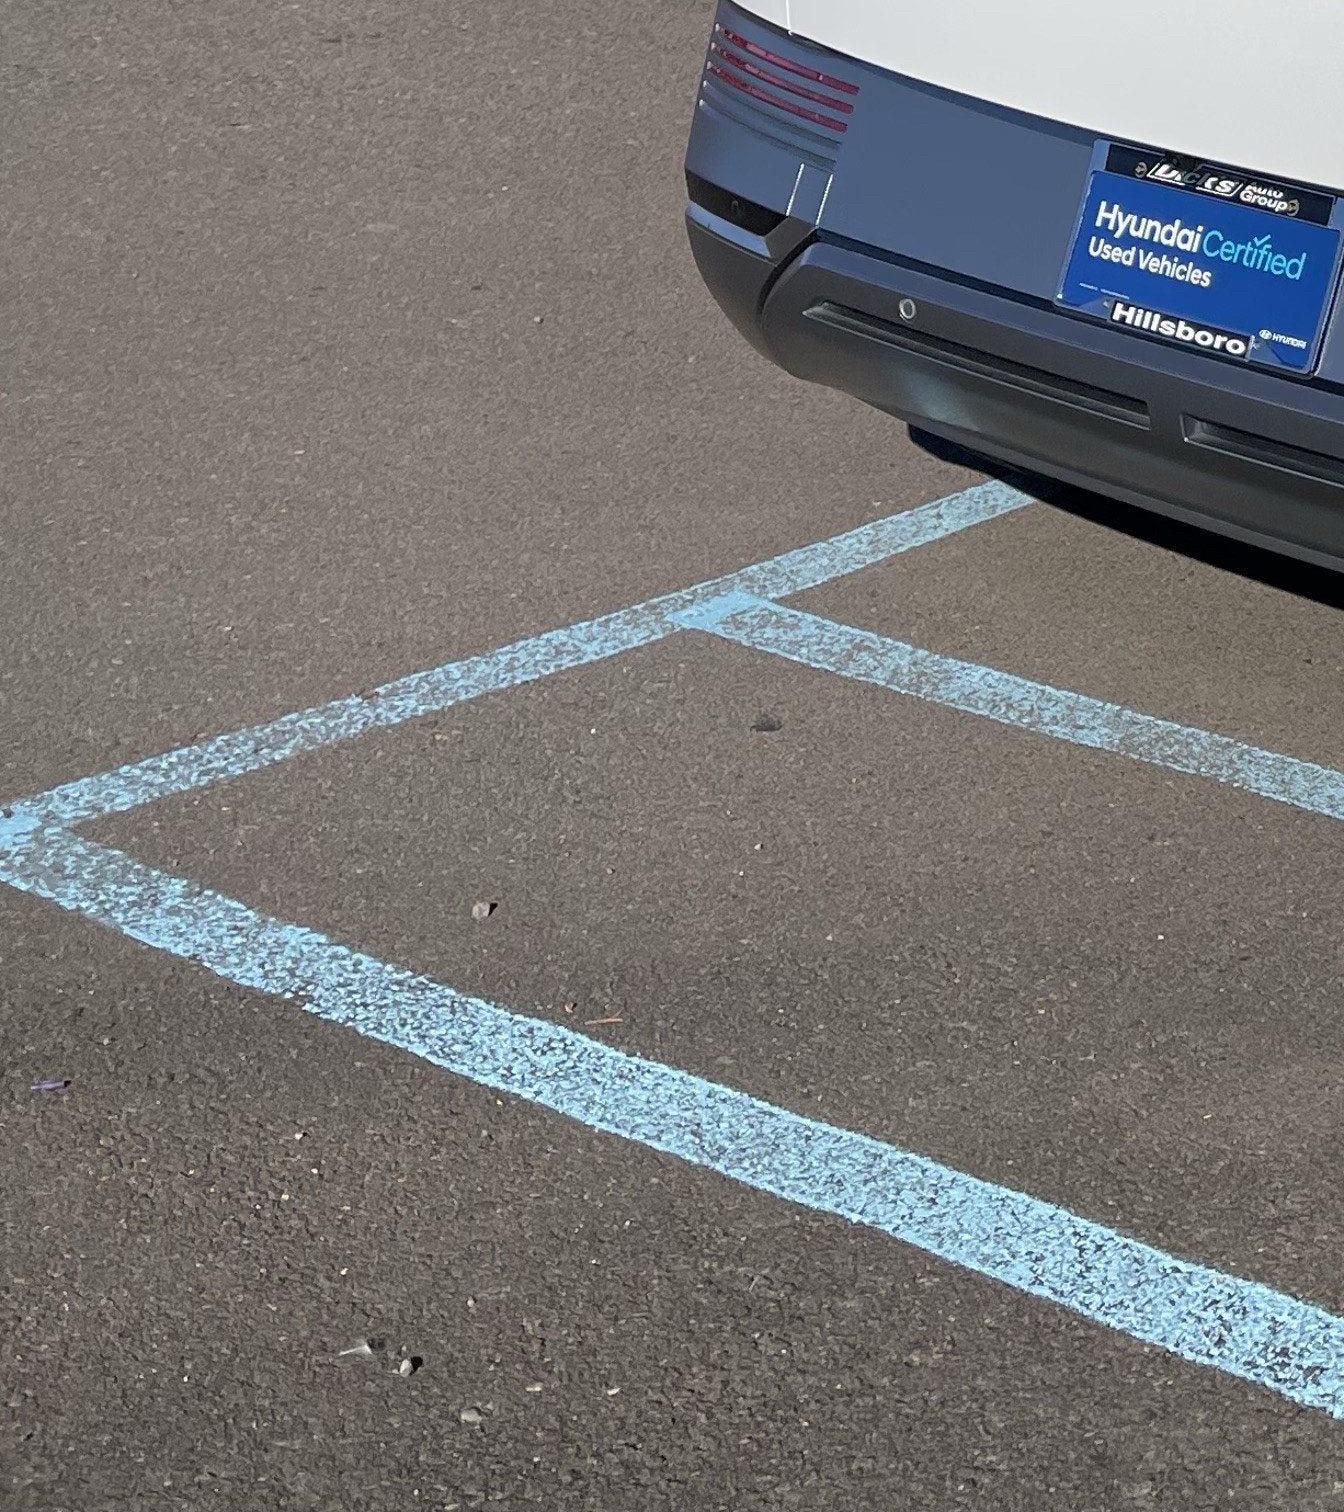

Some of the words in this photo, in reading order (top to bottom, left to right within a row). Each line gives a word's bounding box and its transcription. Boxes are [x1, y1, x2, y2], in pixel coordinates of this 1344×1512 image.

[1239, 190, 1288, 213] Group
[1245, 181, 1284, 199] Auto
[1095, 200, 1204, 254] Hyundai
[1202, 229, 1307, 281] Certified
[1088, 235, 1137, 267] Used
[1138, 247, 1213, 288] Vehicles
[1112, 301, 1247, 356] Hillsboro
[1271, 332, 1308, 350] HYUNDAI
